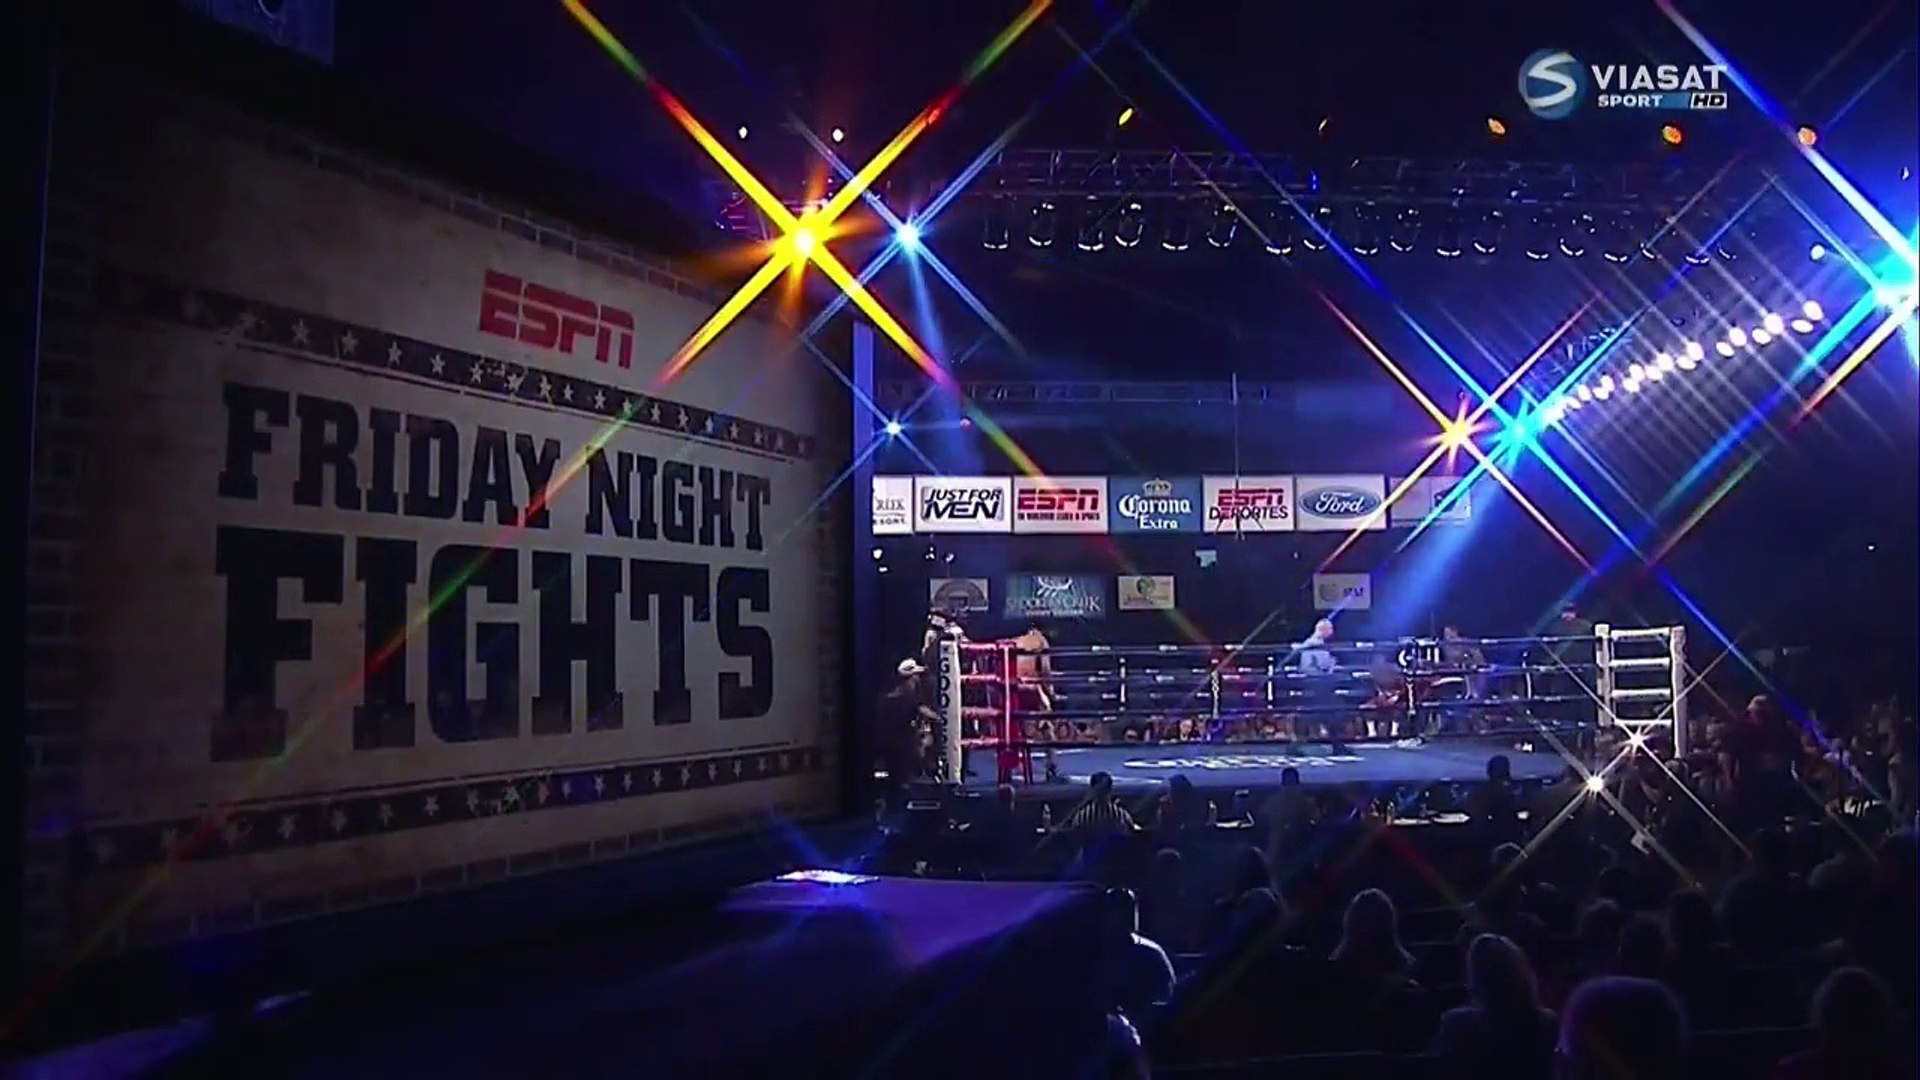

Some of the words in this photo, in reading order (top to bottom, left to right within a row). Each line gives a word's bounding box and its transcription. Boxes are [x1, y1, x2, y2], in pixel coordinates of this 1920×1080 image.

[480, 268, 635, 369] ESPN
[218, 382, 561, 529] FRIDAY
[585, 445, 771, 552] NIGHT
[924, 488, 968, 503] JUST
[968, 488, 1003, 501] FOR
[1017, 488, 1100, 510] ESPN
[1118, 494, 1193, 519] Corona
[1217, 488, 1284, 506] ESPN
[1315, 491, 1364, 513] Ford
[924, 501, 999, 519] MEN
[1209, 506, 1289, 520] DEPORTES
[1139, 514, 1179, 529] Extra
[210, 525, 774, 762] FIGHTS
